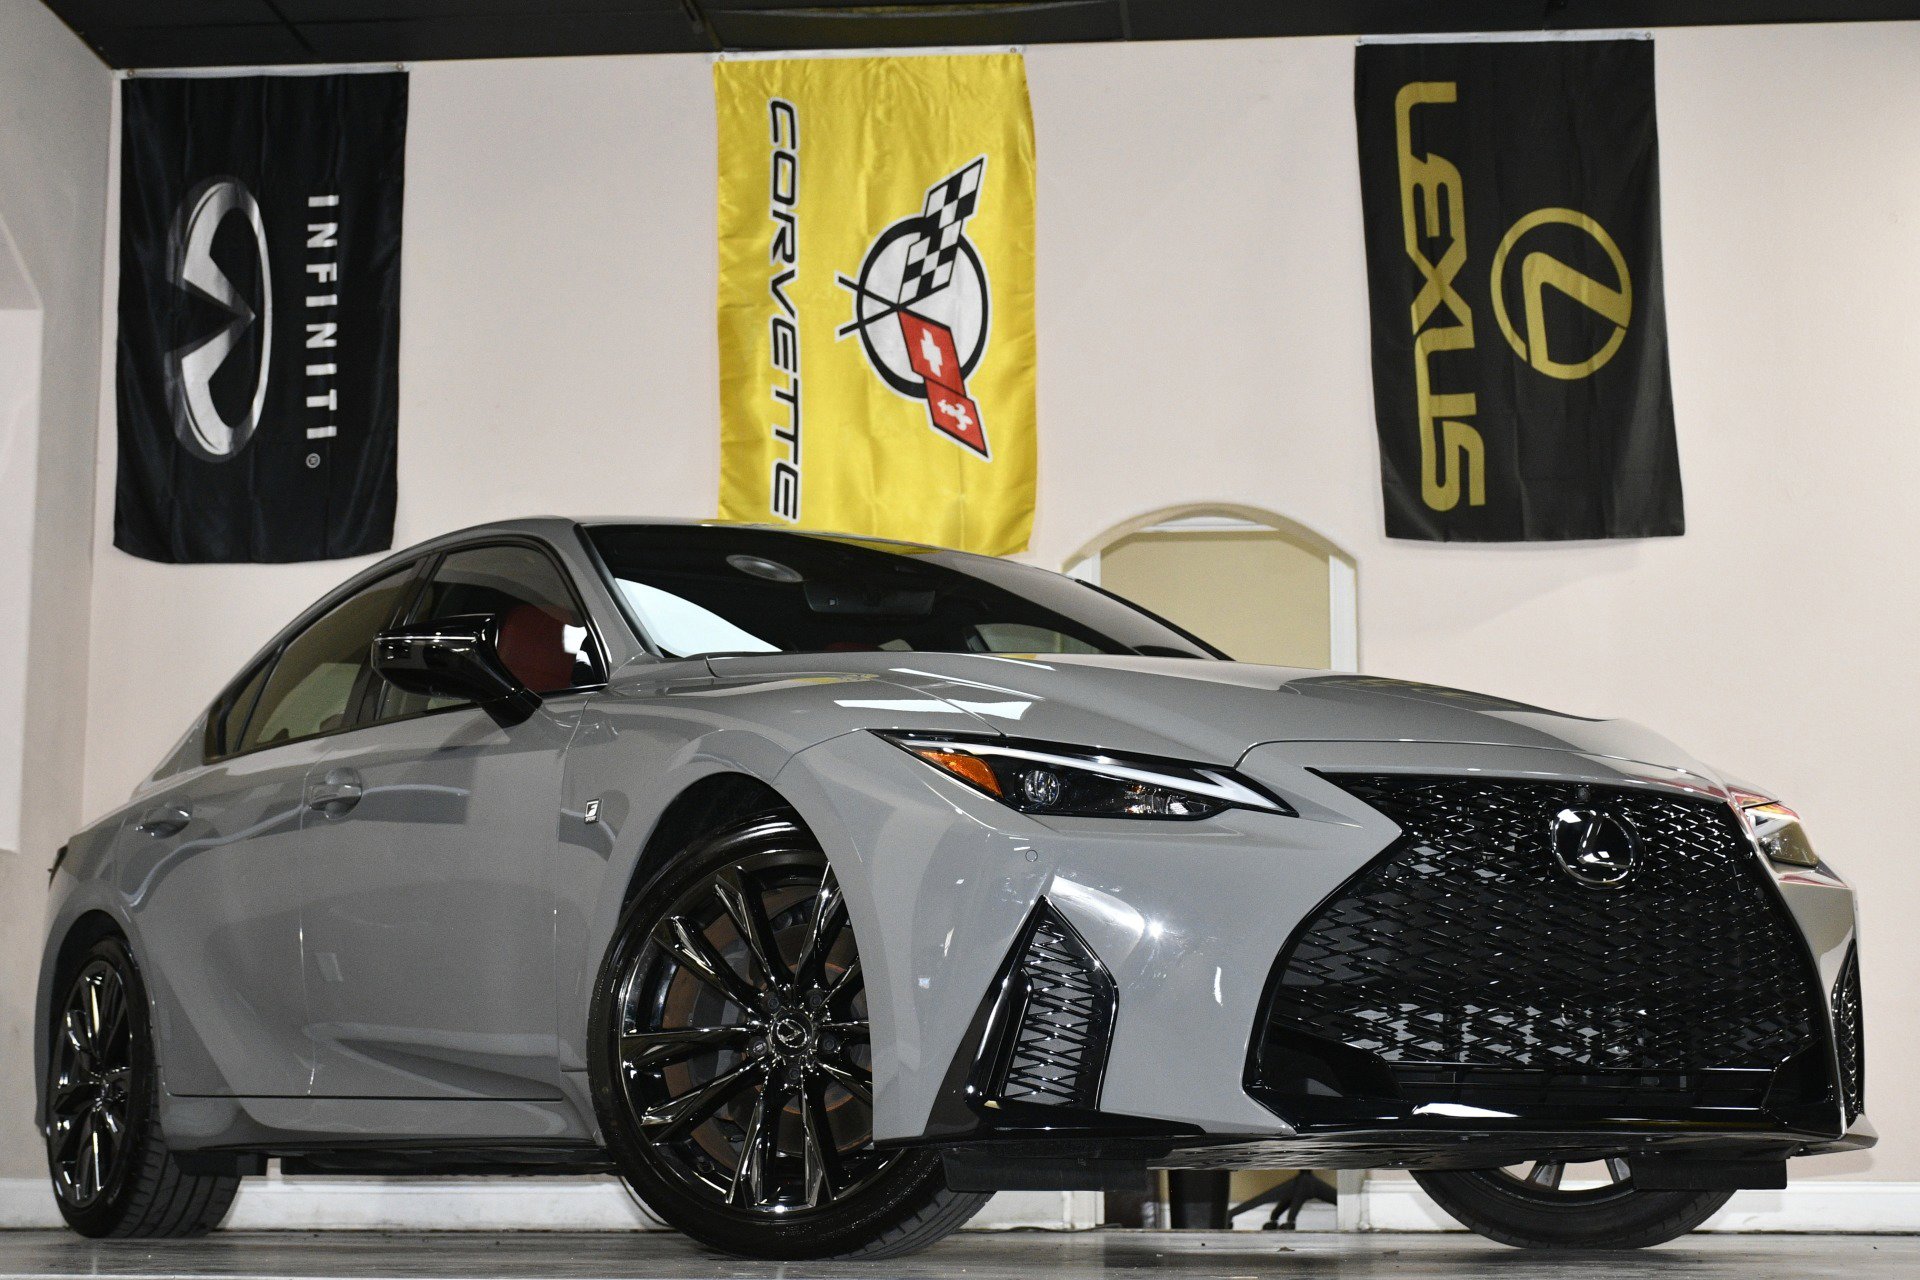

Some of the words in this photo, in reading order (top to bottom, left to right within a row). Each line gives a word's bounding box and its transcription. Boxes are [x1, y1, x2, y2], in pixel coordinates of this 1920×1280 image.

[305, 194, 339, 440] INFINITI
[769, 98, 799, 521] CORVETTE
[1394, 81, 1486, 512] LEXUS
